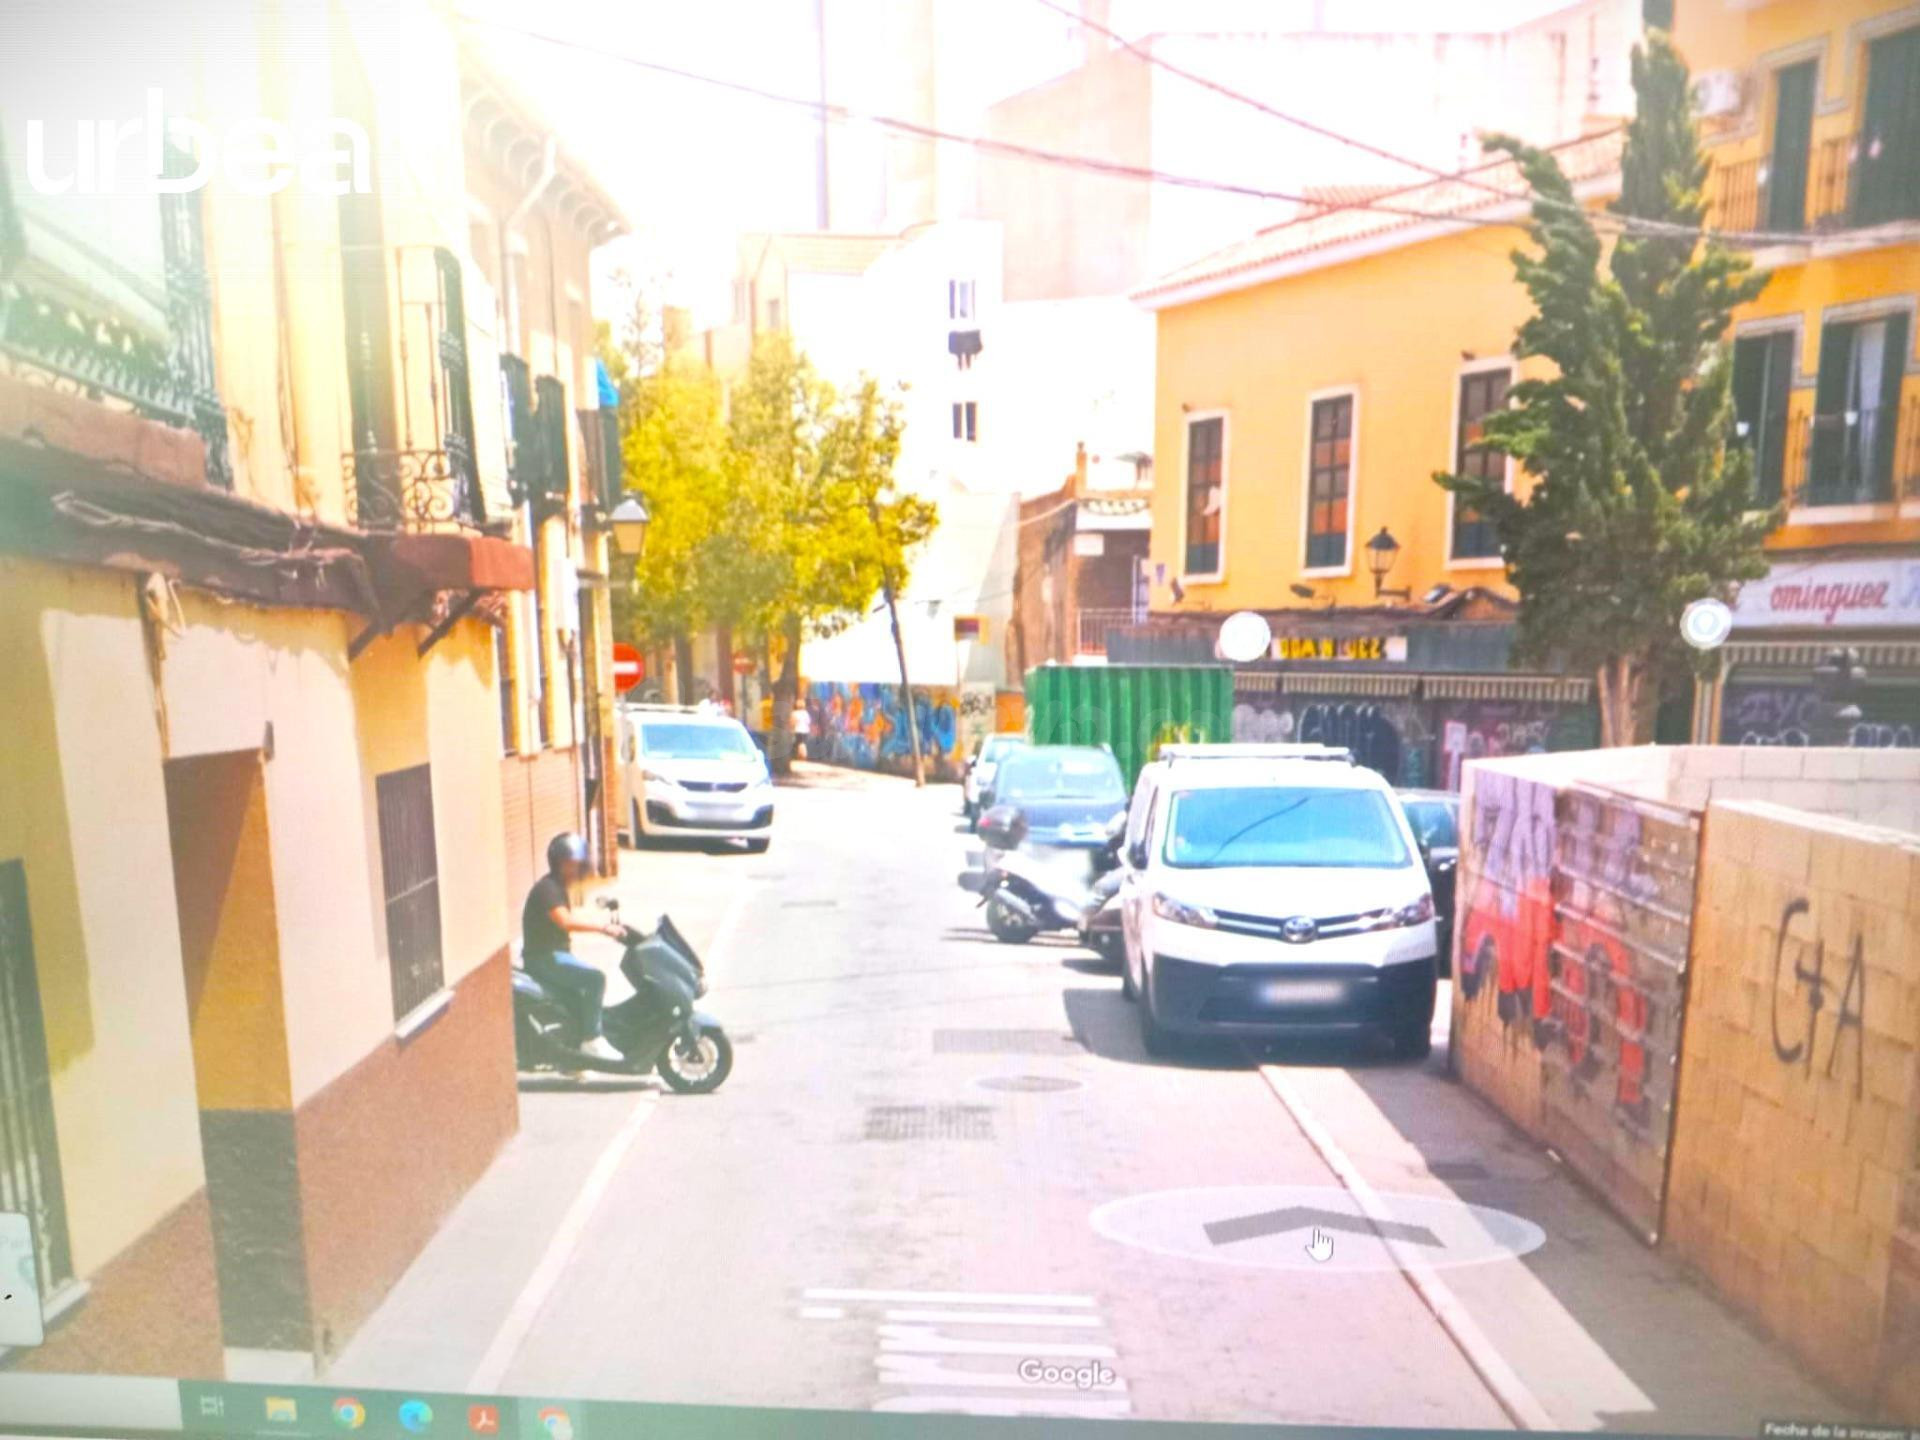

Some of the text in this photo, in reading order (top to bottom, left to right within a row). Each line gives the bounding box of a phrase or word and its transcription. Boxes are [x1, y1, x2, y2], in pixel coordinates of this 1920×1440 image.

[1018, 1359, 1115, 1390] Google
[1764, 1422, 1809, 1437] Fecha
[1812, 1424, 1831, 1438] de
[1833, 1425, 1847, 1438] la
